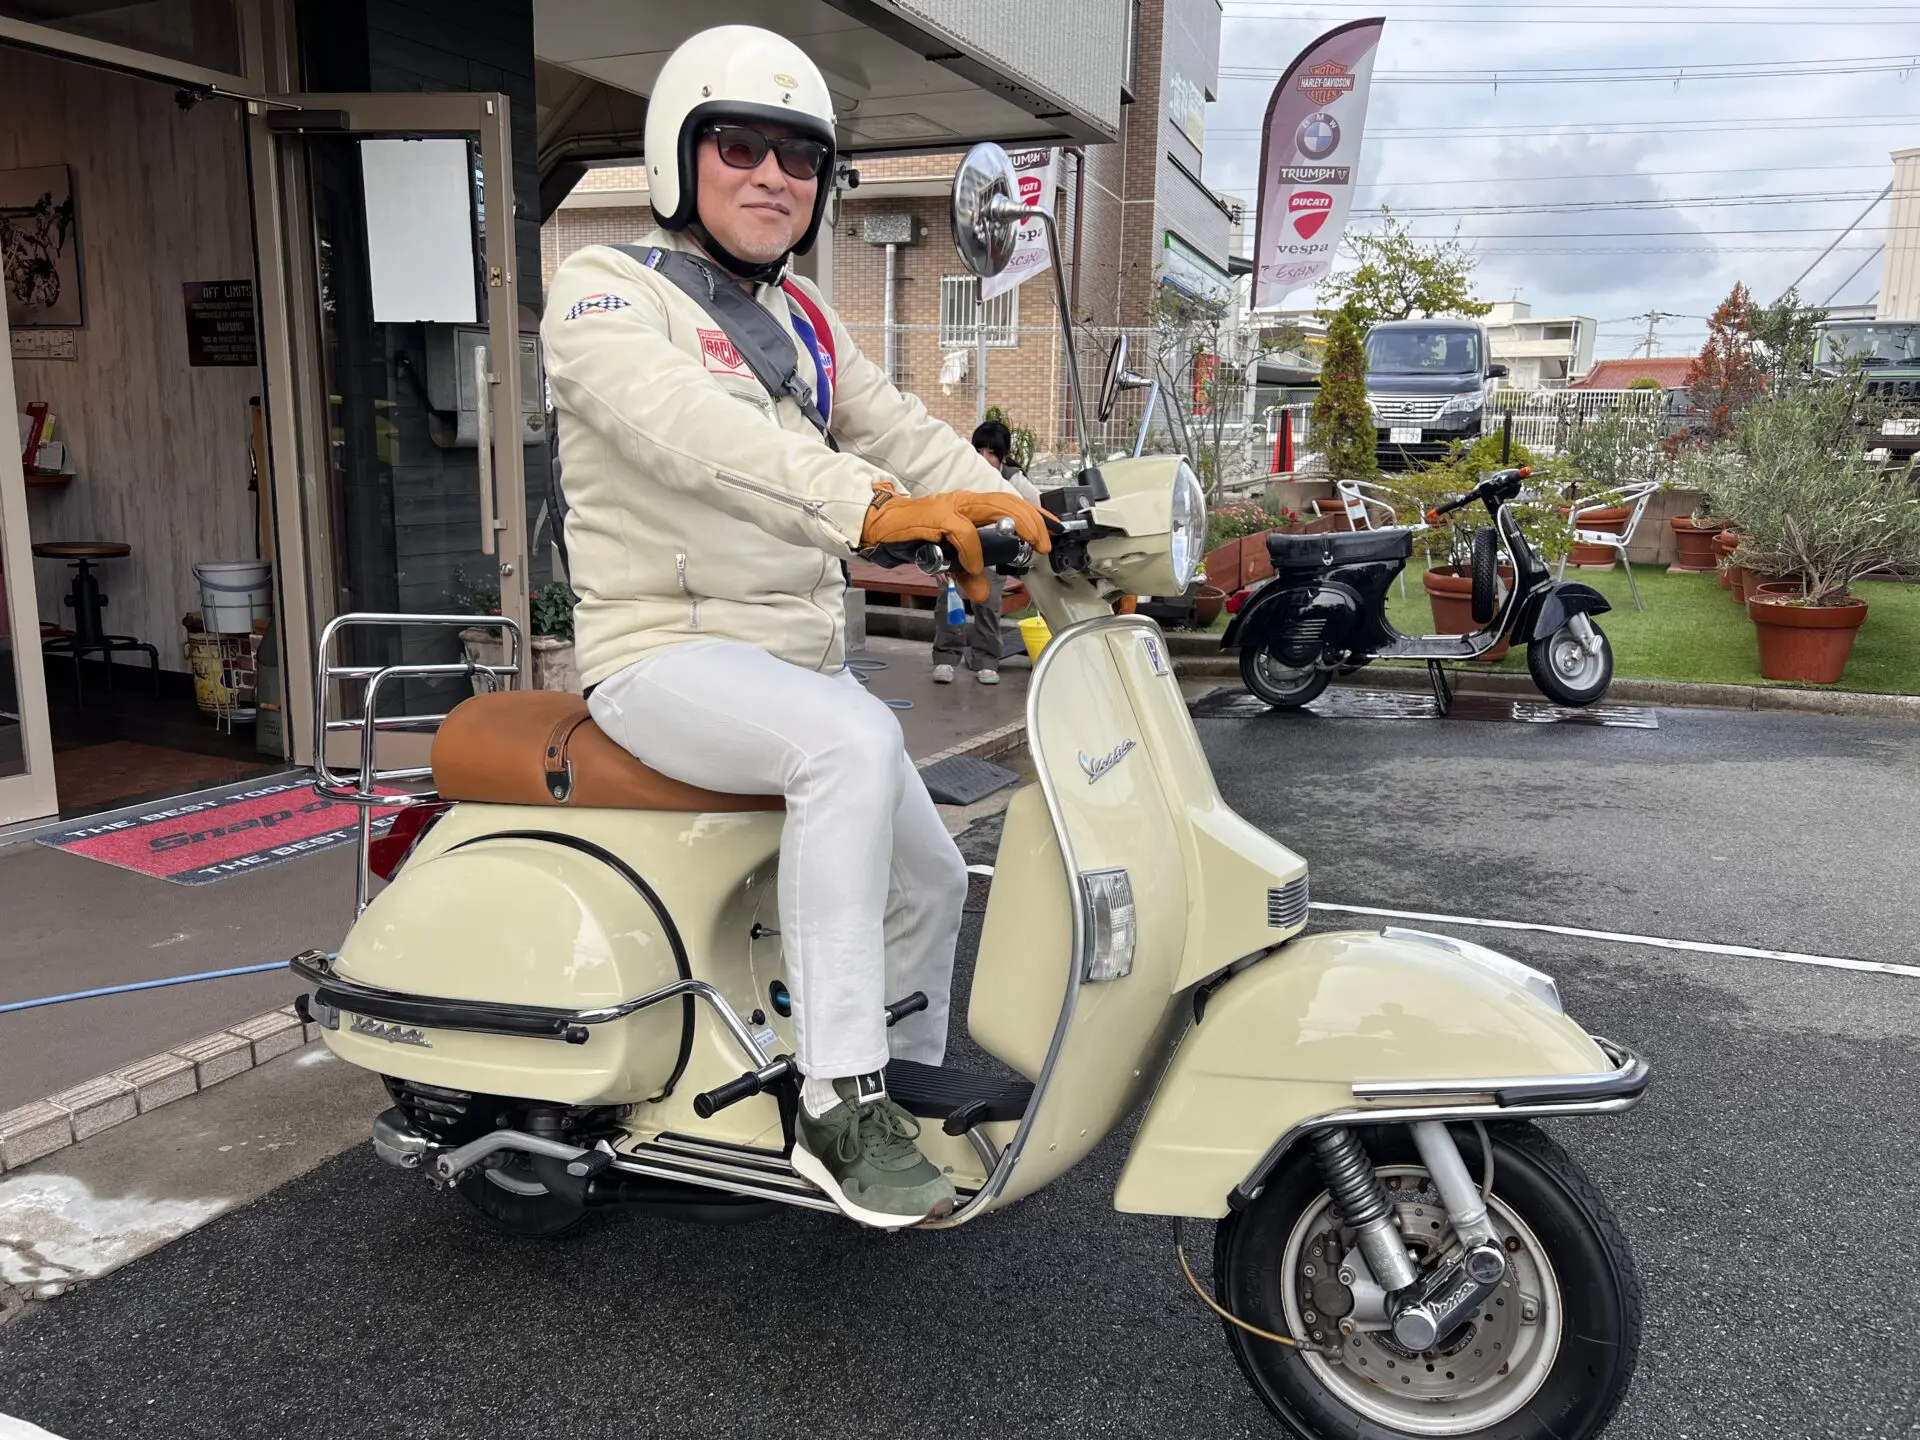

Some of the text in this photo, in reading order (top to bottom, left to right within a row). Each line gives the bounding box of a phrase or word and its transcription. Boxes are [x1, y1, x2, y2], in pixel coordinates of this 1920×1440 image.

[1314, 63, 1341, 75] MOTOR
[1301, 77, 1352, 89] HARLEY-DAVIDSON
[1310, 90, 1338, 103] CYCLES
[1302, 113, 1338, 129] BMW
[1280, 167, 1336, 183] TRIUMPH
[1291, 197, 1330, 207] DUCATI
[1277, 243, 1329, 256] vespa
[203, 285, 252, 299] OFF LIMITS
[1078, 738, 1137, 785] Vespa
[65, 778, 316, 838] THE BEST TOOLS
[198, 830, 348, 875] THE BEST
[1427, 1282, 1478, 1316] Vespa
